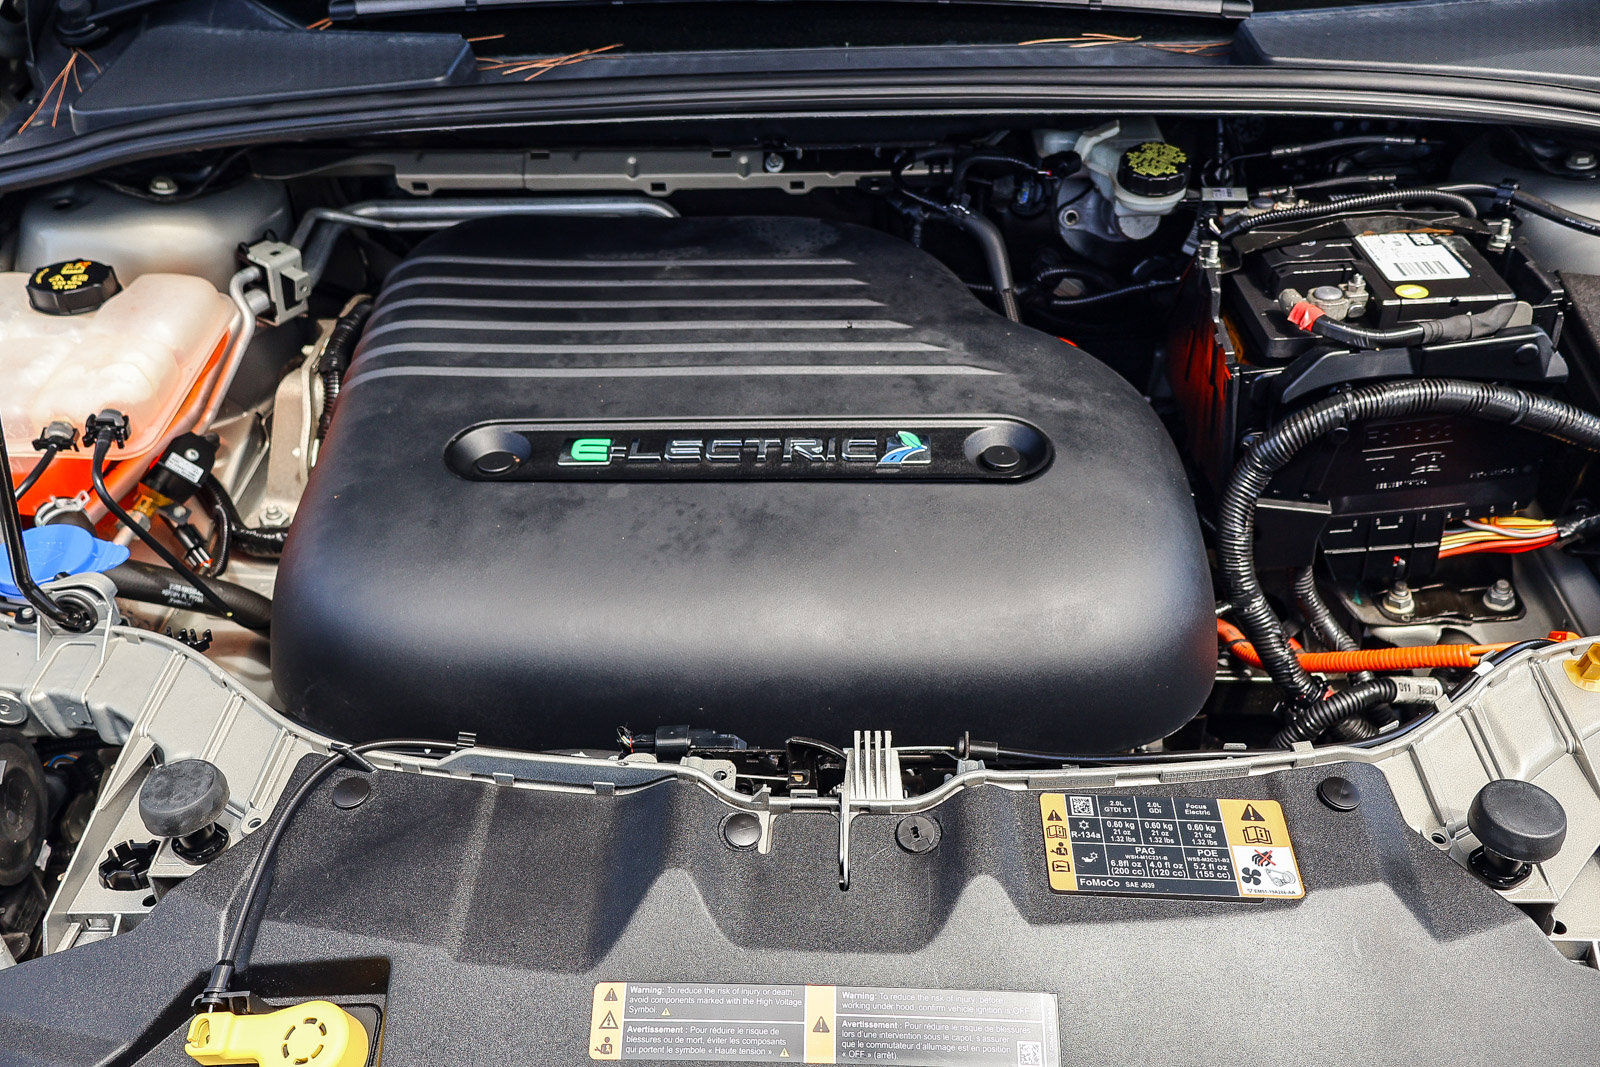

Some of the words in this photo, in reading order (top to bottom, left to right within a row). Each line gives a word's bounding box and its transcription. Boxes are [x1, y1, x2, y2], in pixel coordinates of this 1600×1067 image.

[1163, 822, 1173, 831] kg
[1206, 824, 1216, 833] kg
[1111, 868, 1129, 876] (200
[1195, 870, 1214, 878] (155
[630, 986, 664, 995] Warning:
[741, 988, 760, 996] injury
[842, 992, 876, 1001] Warning:
[757, 998, 773, 1006] High
[775, 998, 802, 1007] Voltage
[842, 1002, 870, 1011] working
[976, 1006, 1002, 1015] ignition
[924, 1022, 949, 1031] réduire
[996, 1026, 1031, 1034] blessures
[880, 1031, 921, 1039] intervention
[639, 1046, 664, 1054] portent
[675, 1047, 705, 1055] symbole
[916, 1042, 955, 1052] d'allumage
